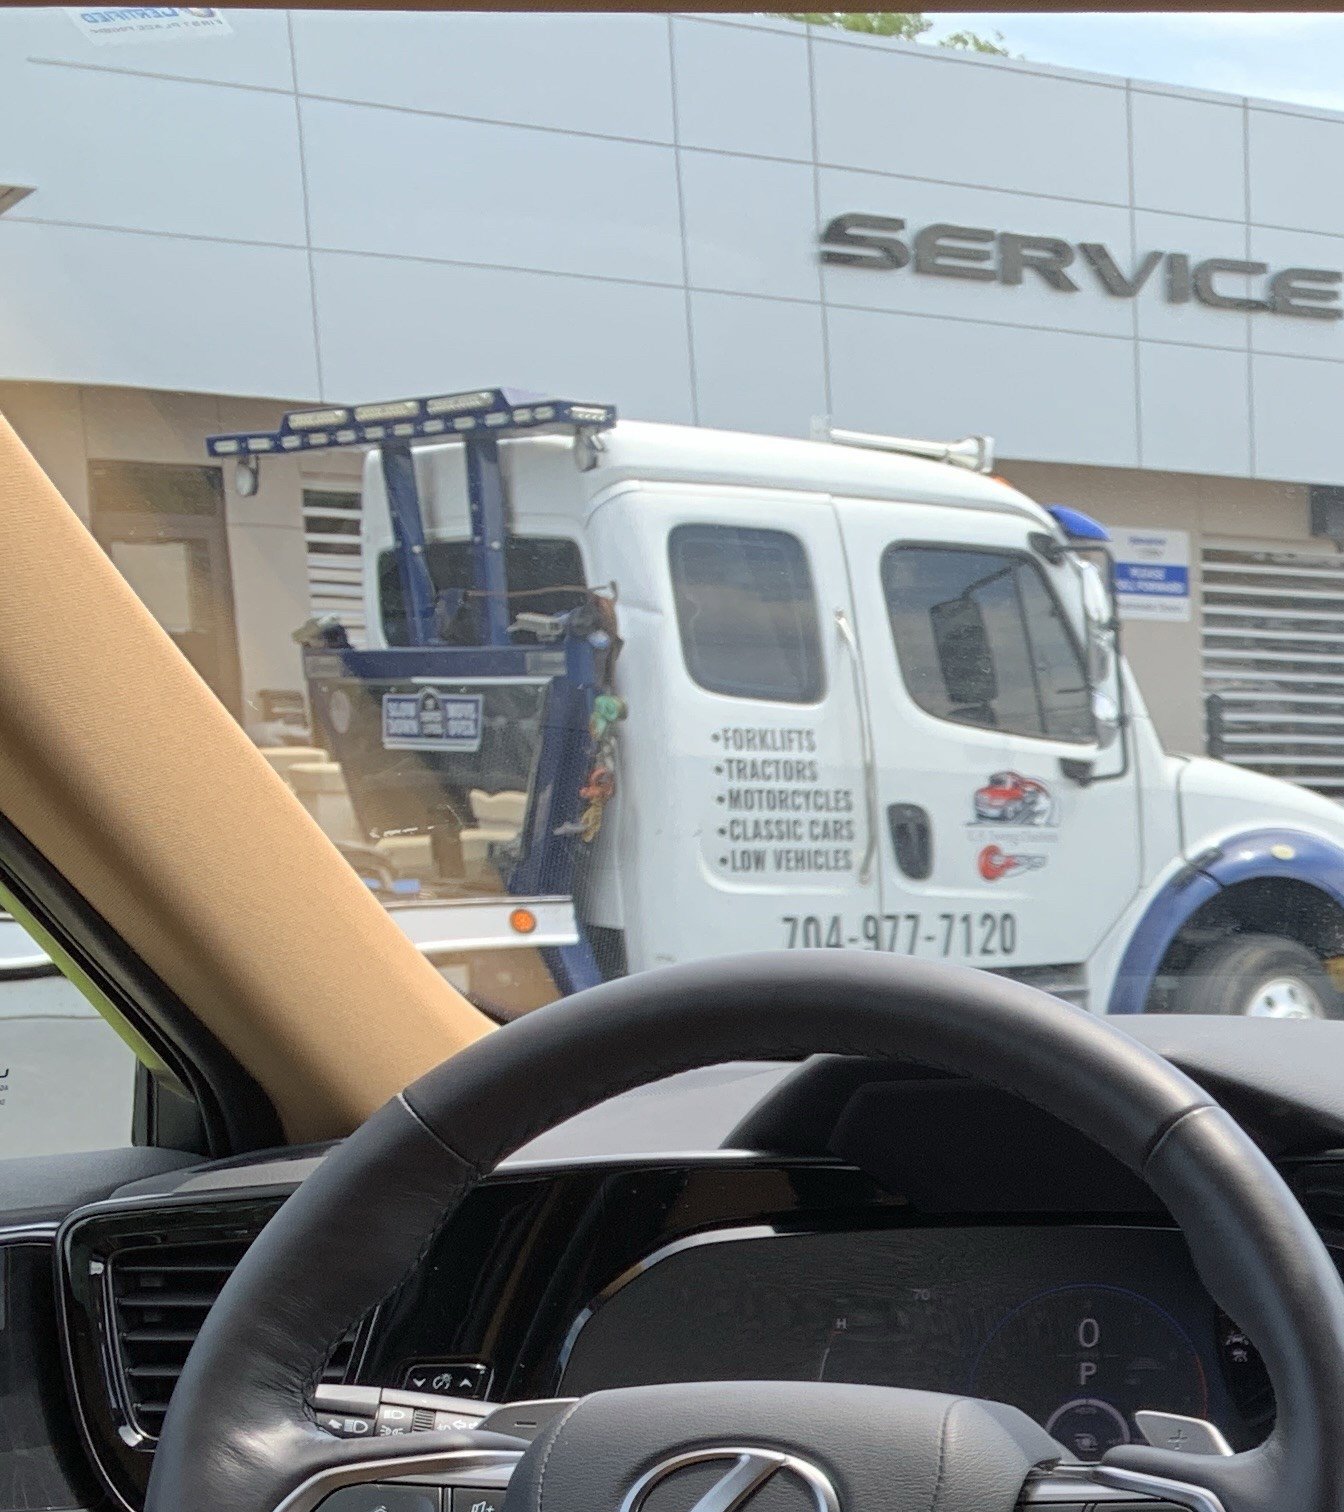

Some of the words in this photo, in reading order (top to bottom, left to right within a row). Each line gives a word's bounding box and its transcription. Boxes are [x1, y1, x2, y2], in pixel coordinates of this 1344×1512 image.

[819, 212, 1344, 321] SERVICE
[722, 728, 817, 752] FORKLIFTS
[726, 758, 818, 782] TRACTORS
[728, 788, 853, 812] MOTORCYCLES
[729, 819, 803, 841] CLASSIC
[808, 819, 854, 841] CARS
[731, 849, 767, 872] LOW
[773, 849, 853, 872] VEHICLES
[782, 912, 1018, 957] 704-977-7120
[1080, 1361, 1098, 1386] P
